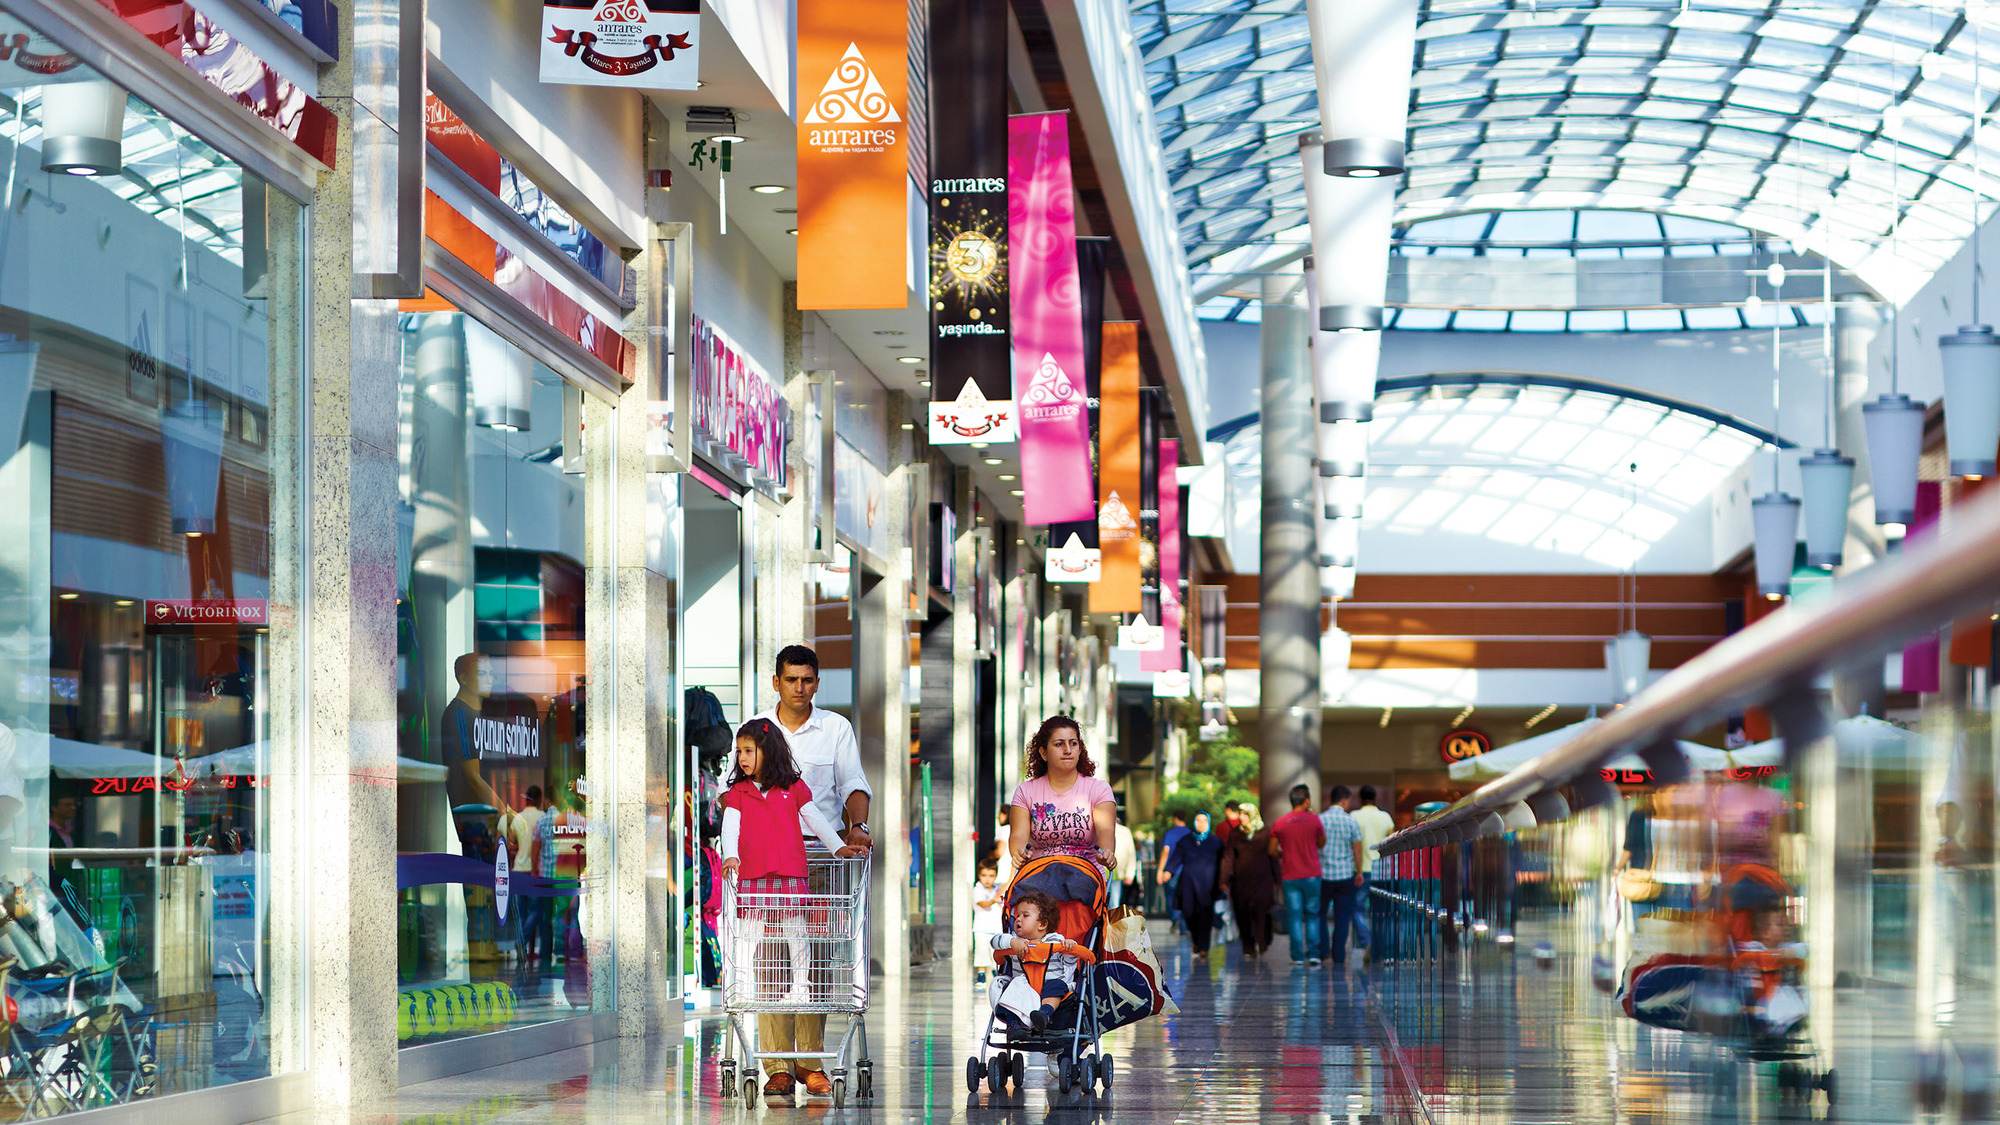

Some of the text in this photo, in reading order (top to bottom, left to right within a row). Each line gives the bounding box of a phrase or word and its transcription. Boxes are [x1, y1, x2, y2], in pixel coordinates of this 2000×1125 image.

[597, 24, 643, 33] antares
[587, 54, 613, 70] Antares
[614, 61, 622, 74] 3
[809, 129, 896, 146] antares
[932, 177, 1006, 194] antares
[958, 239, 985, 274] 3
[129, 351, 156, 380] adidas
[1023, 403, 1081, 419] antares
[173, 605, 261, 619] VICTORINOX
[473, 715, 539, 760] oyunun sahibi ol
[1039, 811, 1091, 832] EVERY
